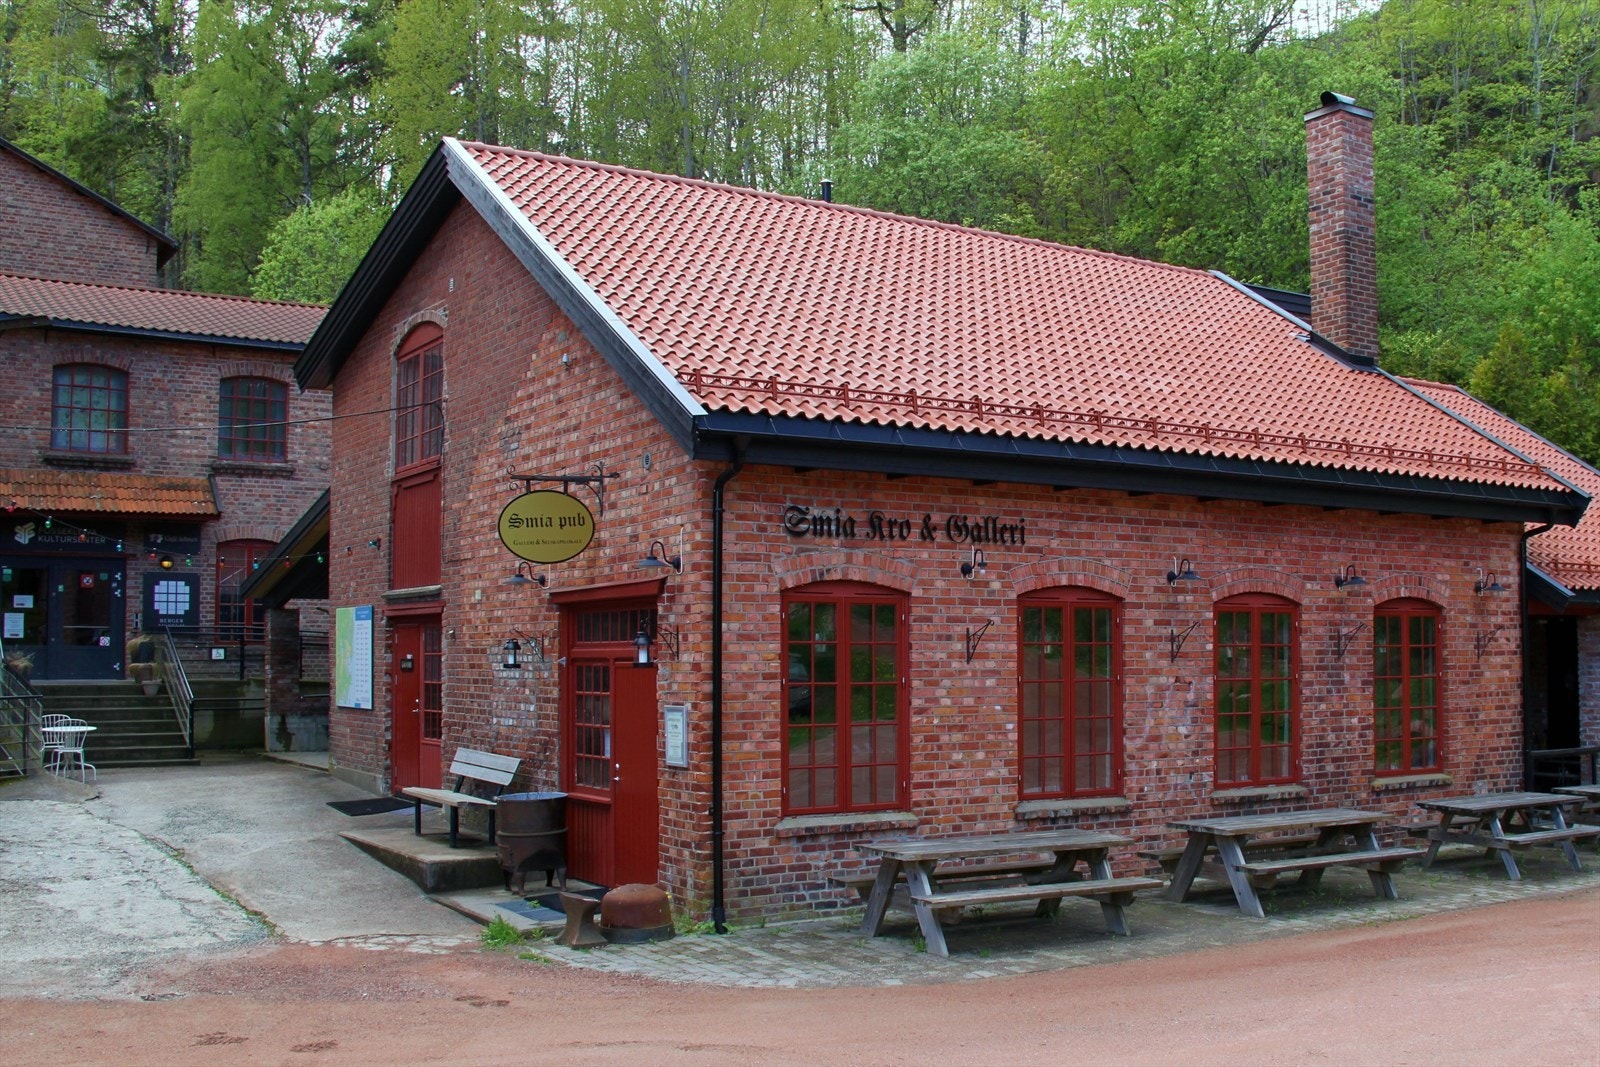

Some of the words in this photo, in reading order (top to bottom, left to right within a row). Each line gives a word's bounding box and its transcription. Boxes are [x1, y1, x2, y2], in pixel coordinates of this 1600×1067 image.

[508, 513, 553, 529] Smia
[558, 512, 586, 530] pub
[784, 505, 856, 538] Smia
[866, 509, 911, 541] Kro
[919, 513, 938, 542] &
[946, 514, 1026, 545] Galleri
